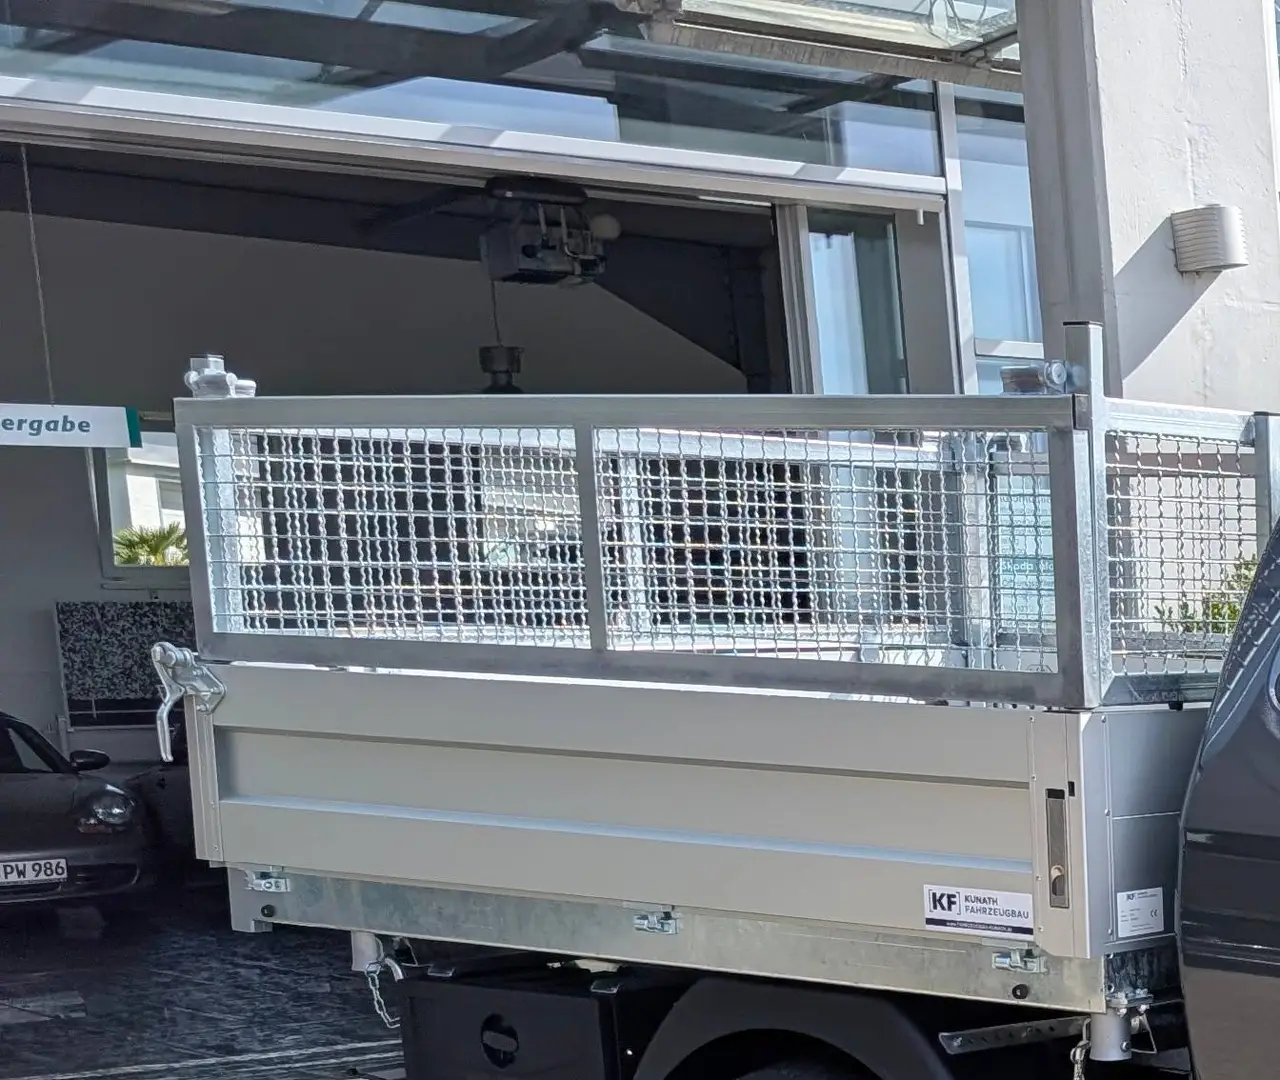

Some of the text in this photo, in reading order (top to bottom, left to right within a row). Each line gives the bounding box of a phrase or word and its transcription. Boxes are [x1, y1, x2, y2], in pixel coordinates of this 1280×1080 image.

[1, 414, 91, 437] ergabe
[3, 861, 66, 879] PW 986
[964, 894, 999, 906] KUNATH
[965, 905, 1030, 920] FAHRZEUGBAU
